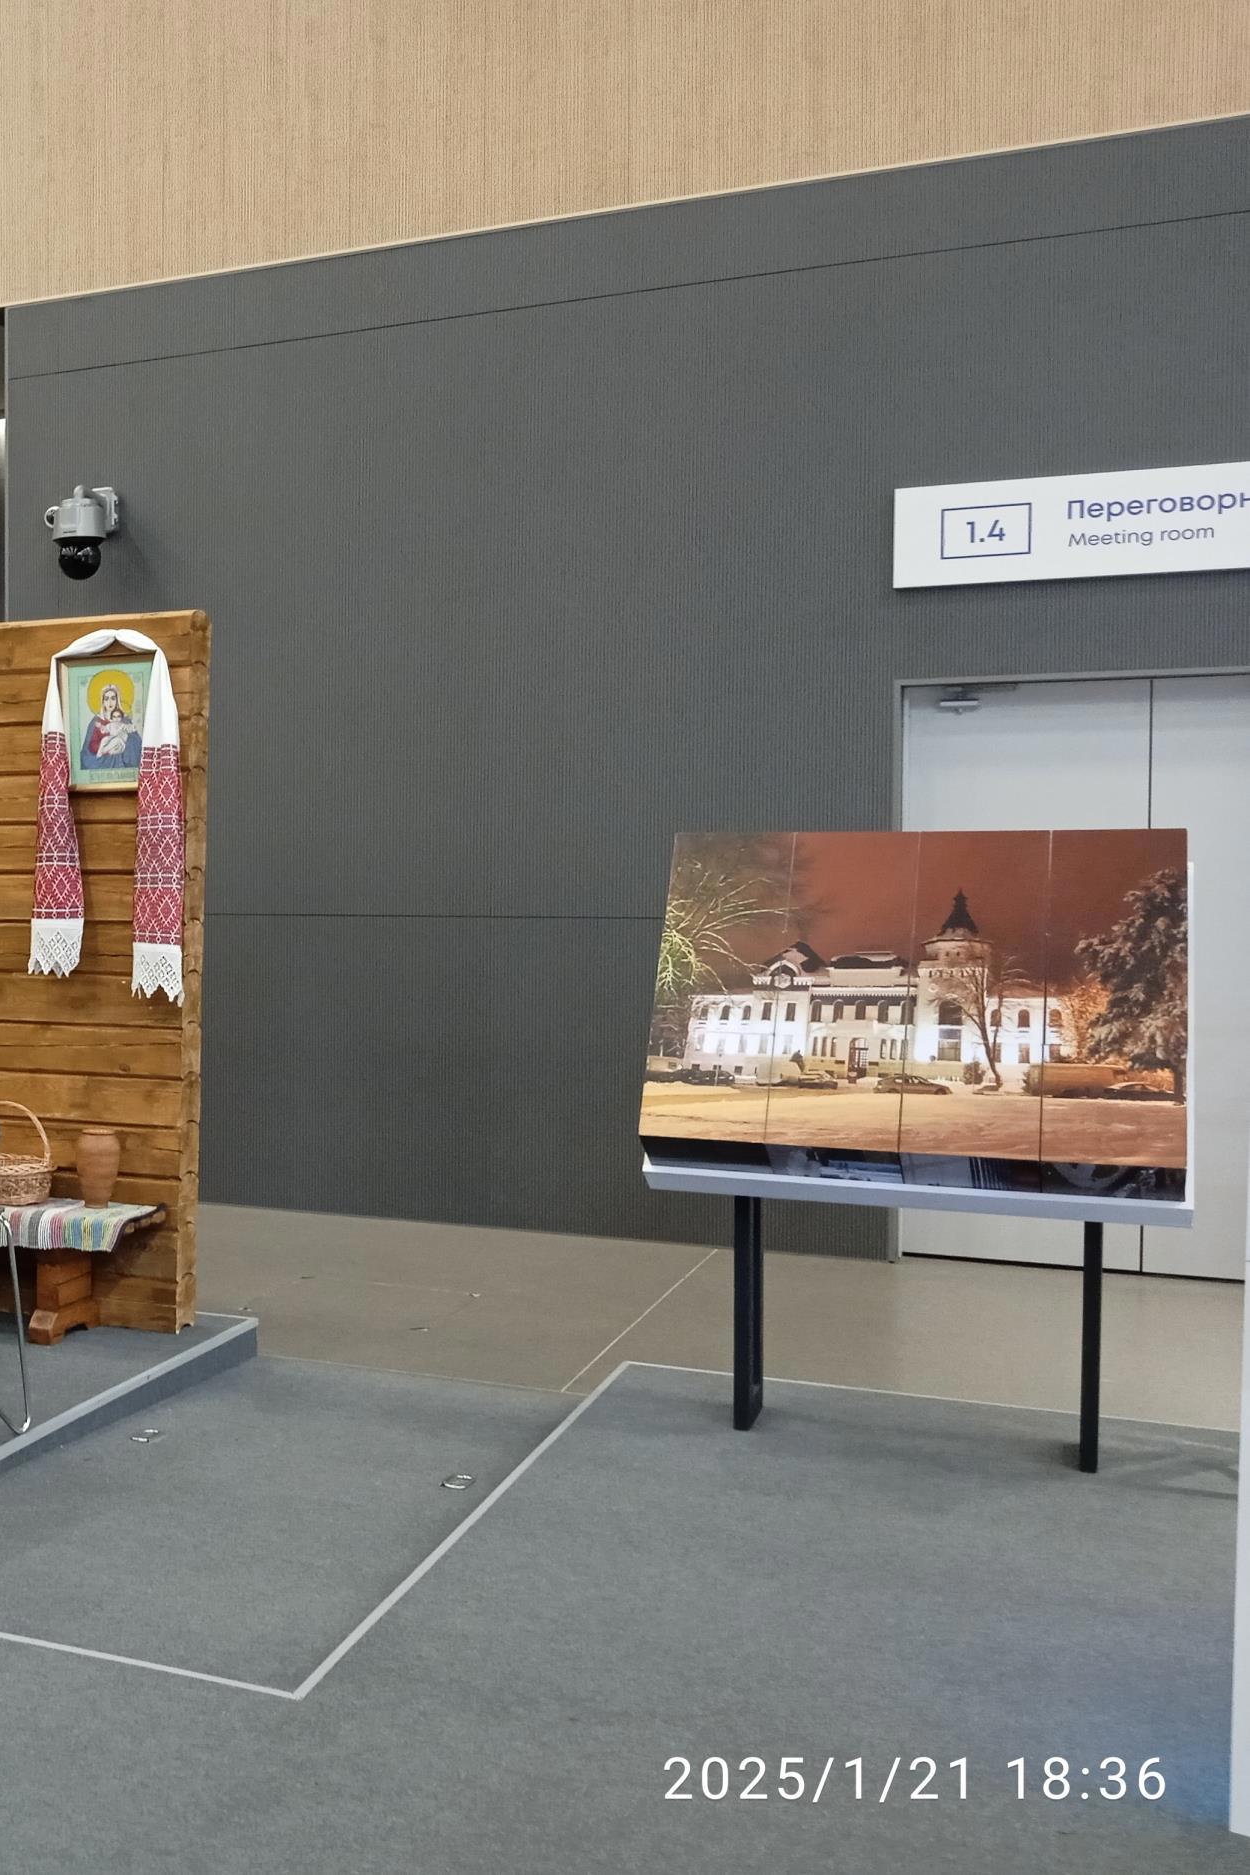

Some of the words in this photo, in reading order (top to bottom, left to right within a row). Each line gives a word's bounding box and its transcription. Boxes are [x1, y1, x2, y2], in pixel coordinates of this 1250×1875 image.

[965, 519, 1006, 544] 1.4
[1068, 529, 1154, 548] Meeting
[1160, 526, 1215, 542] room
